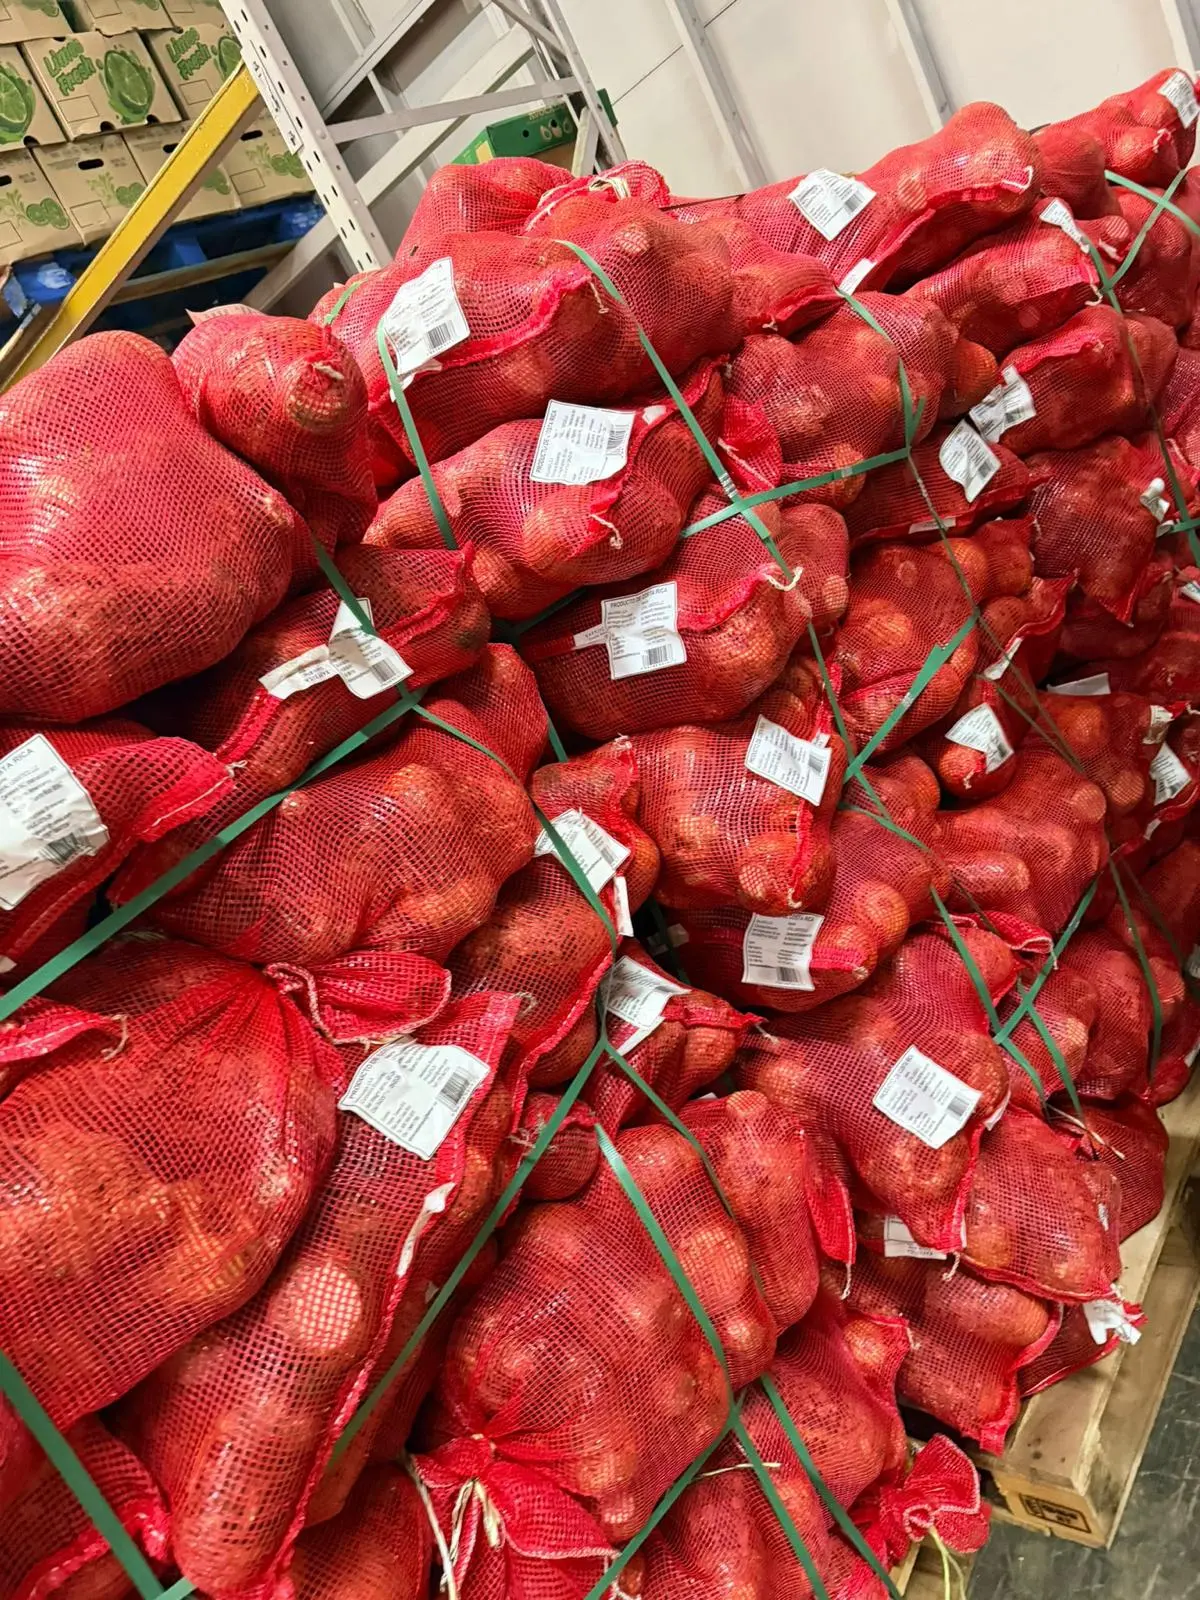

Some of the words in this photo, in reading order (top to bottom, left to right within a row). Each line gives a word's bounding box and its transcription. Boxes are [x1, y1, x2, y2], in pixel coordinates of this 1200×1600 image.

[43, 38, 84, 78] Lime
[165, 27, 200, 63] Lime
[177, 41, 211, 80] Fresh
[56, 54, 96, 96] Fresh
[12, 747, 33, 764] RICA
